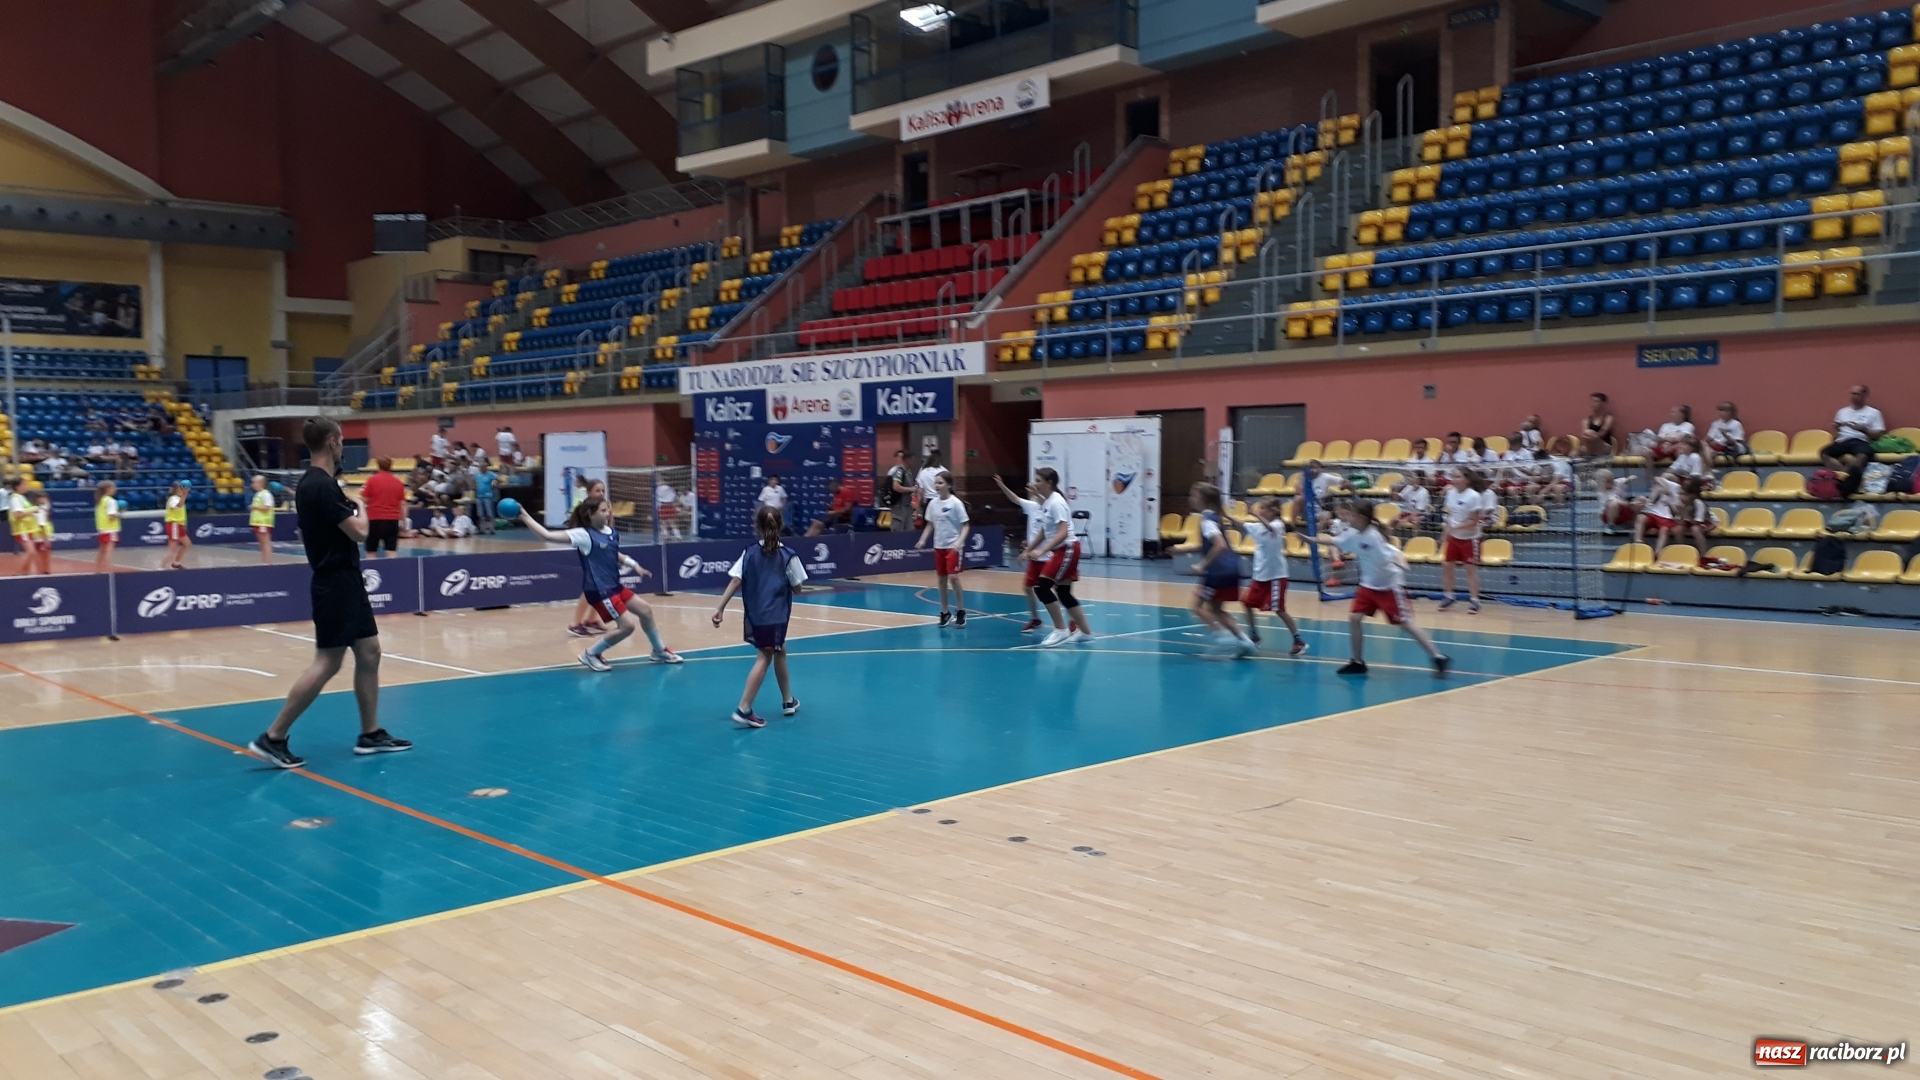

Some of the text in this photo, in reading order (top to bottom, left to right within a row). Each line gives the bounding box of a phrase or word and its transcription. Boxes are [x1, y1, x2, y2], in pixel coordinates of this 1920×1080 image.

[907, 96, 1005, 133] Kalisz Arena
[1641, 345, 1715, 363] SEKTOR J
[686, 370, 708, 390] TU
[790, 361, 817, 386] SIĘ
[820, 347, 967, 382] SZCZYPIORNIAK
[704, 395, 754, 423] Kalisz
[790, 394, 832, 413] Arena
[875, 385, 938, 416] Kalisz
[469, 575, 508, 590] ZPRP
[175, 593, 223, 611] ZPRP
